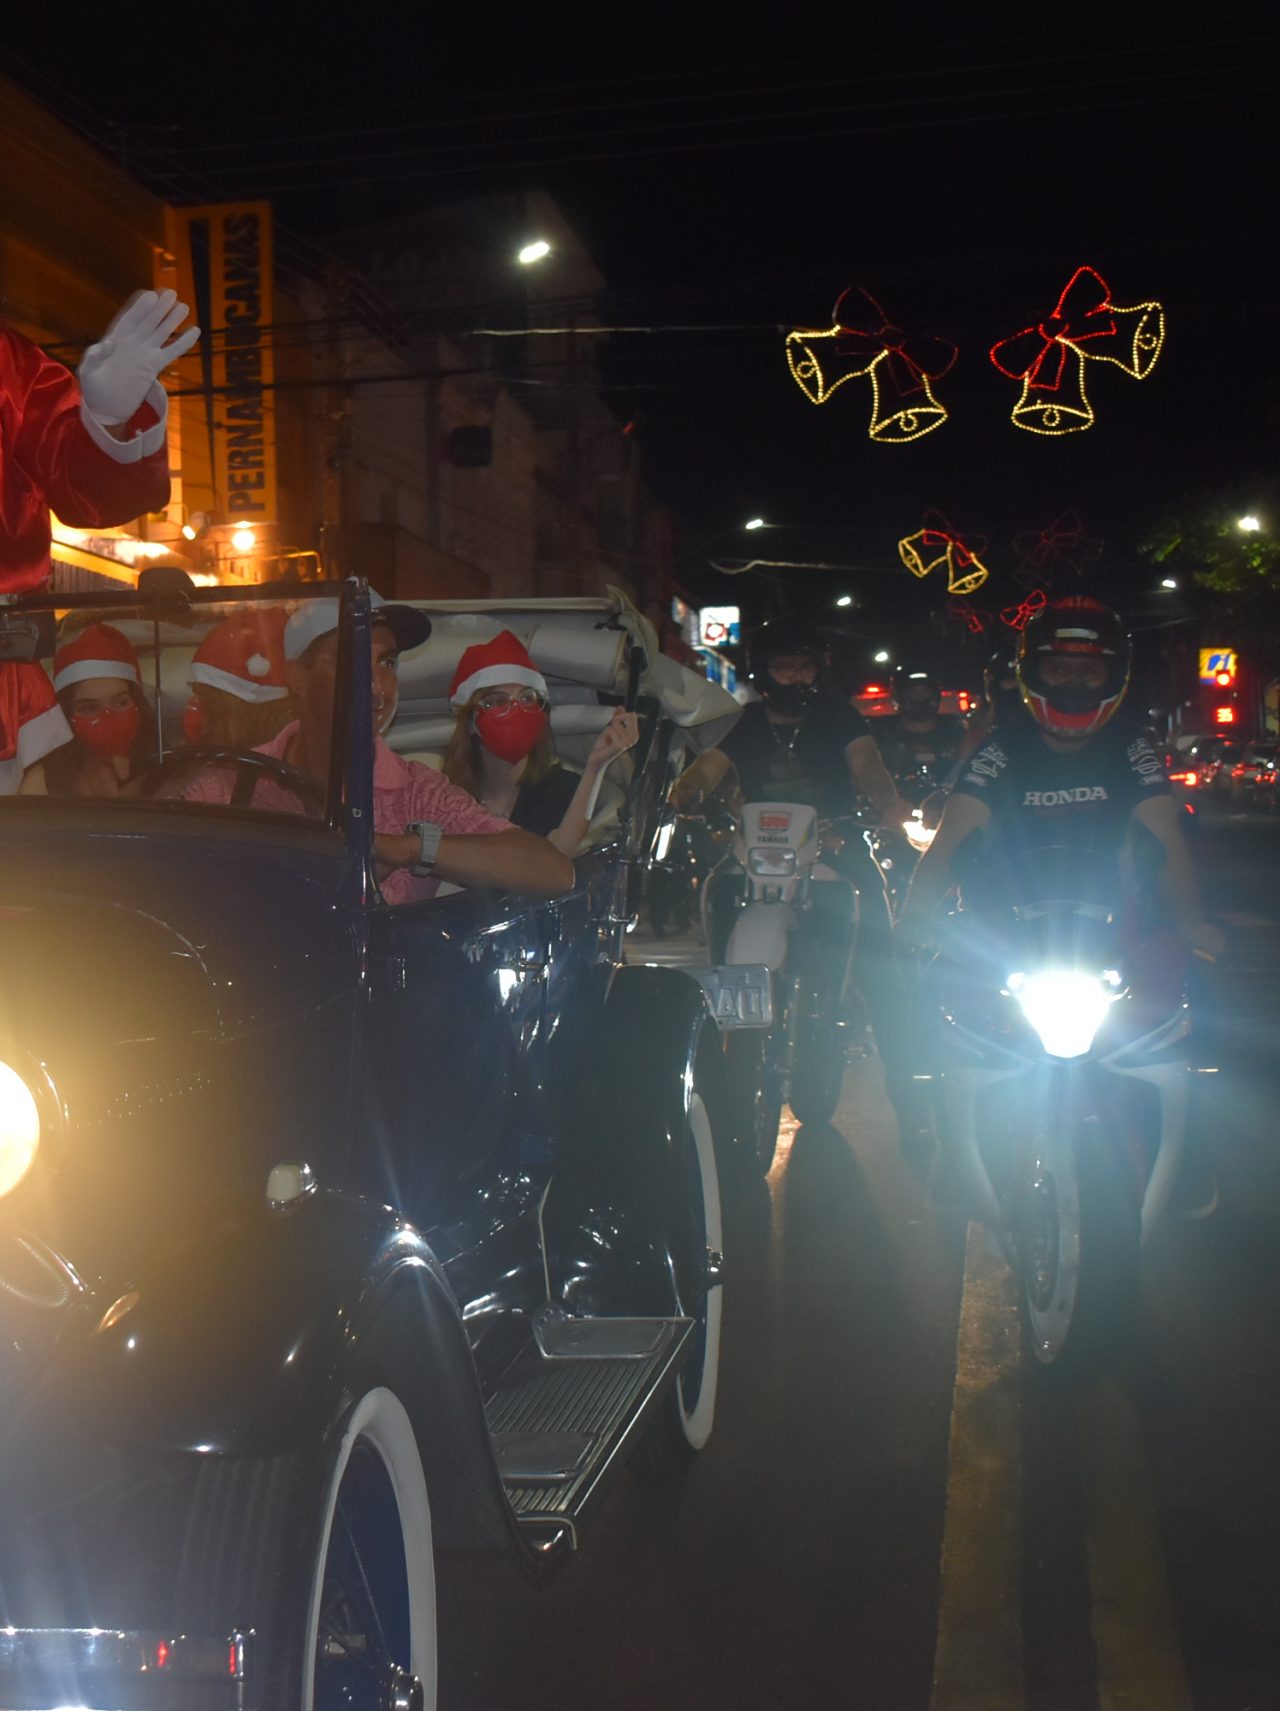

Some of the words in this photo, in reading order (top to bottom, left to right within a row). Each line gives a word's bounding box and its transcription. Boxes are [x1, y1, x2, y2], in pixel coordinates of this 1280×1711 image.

[223, 213, 265, 513] PERNAMBUCANAS
[1022, 787, 1109, 806] HONDA
[757, 835, 789, 843] YAMAHA
